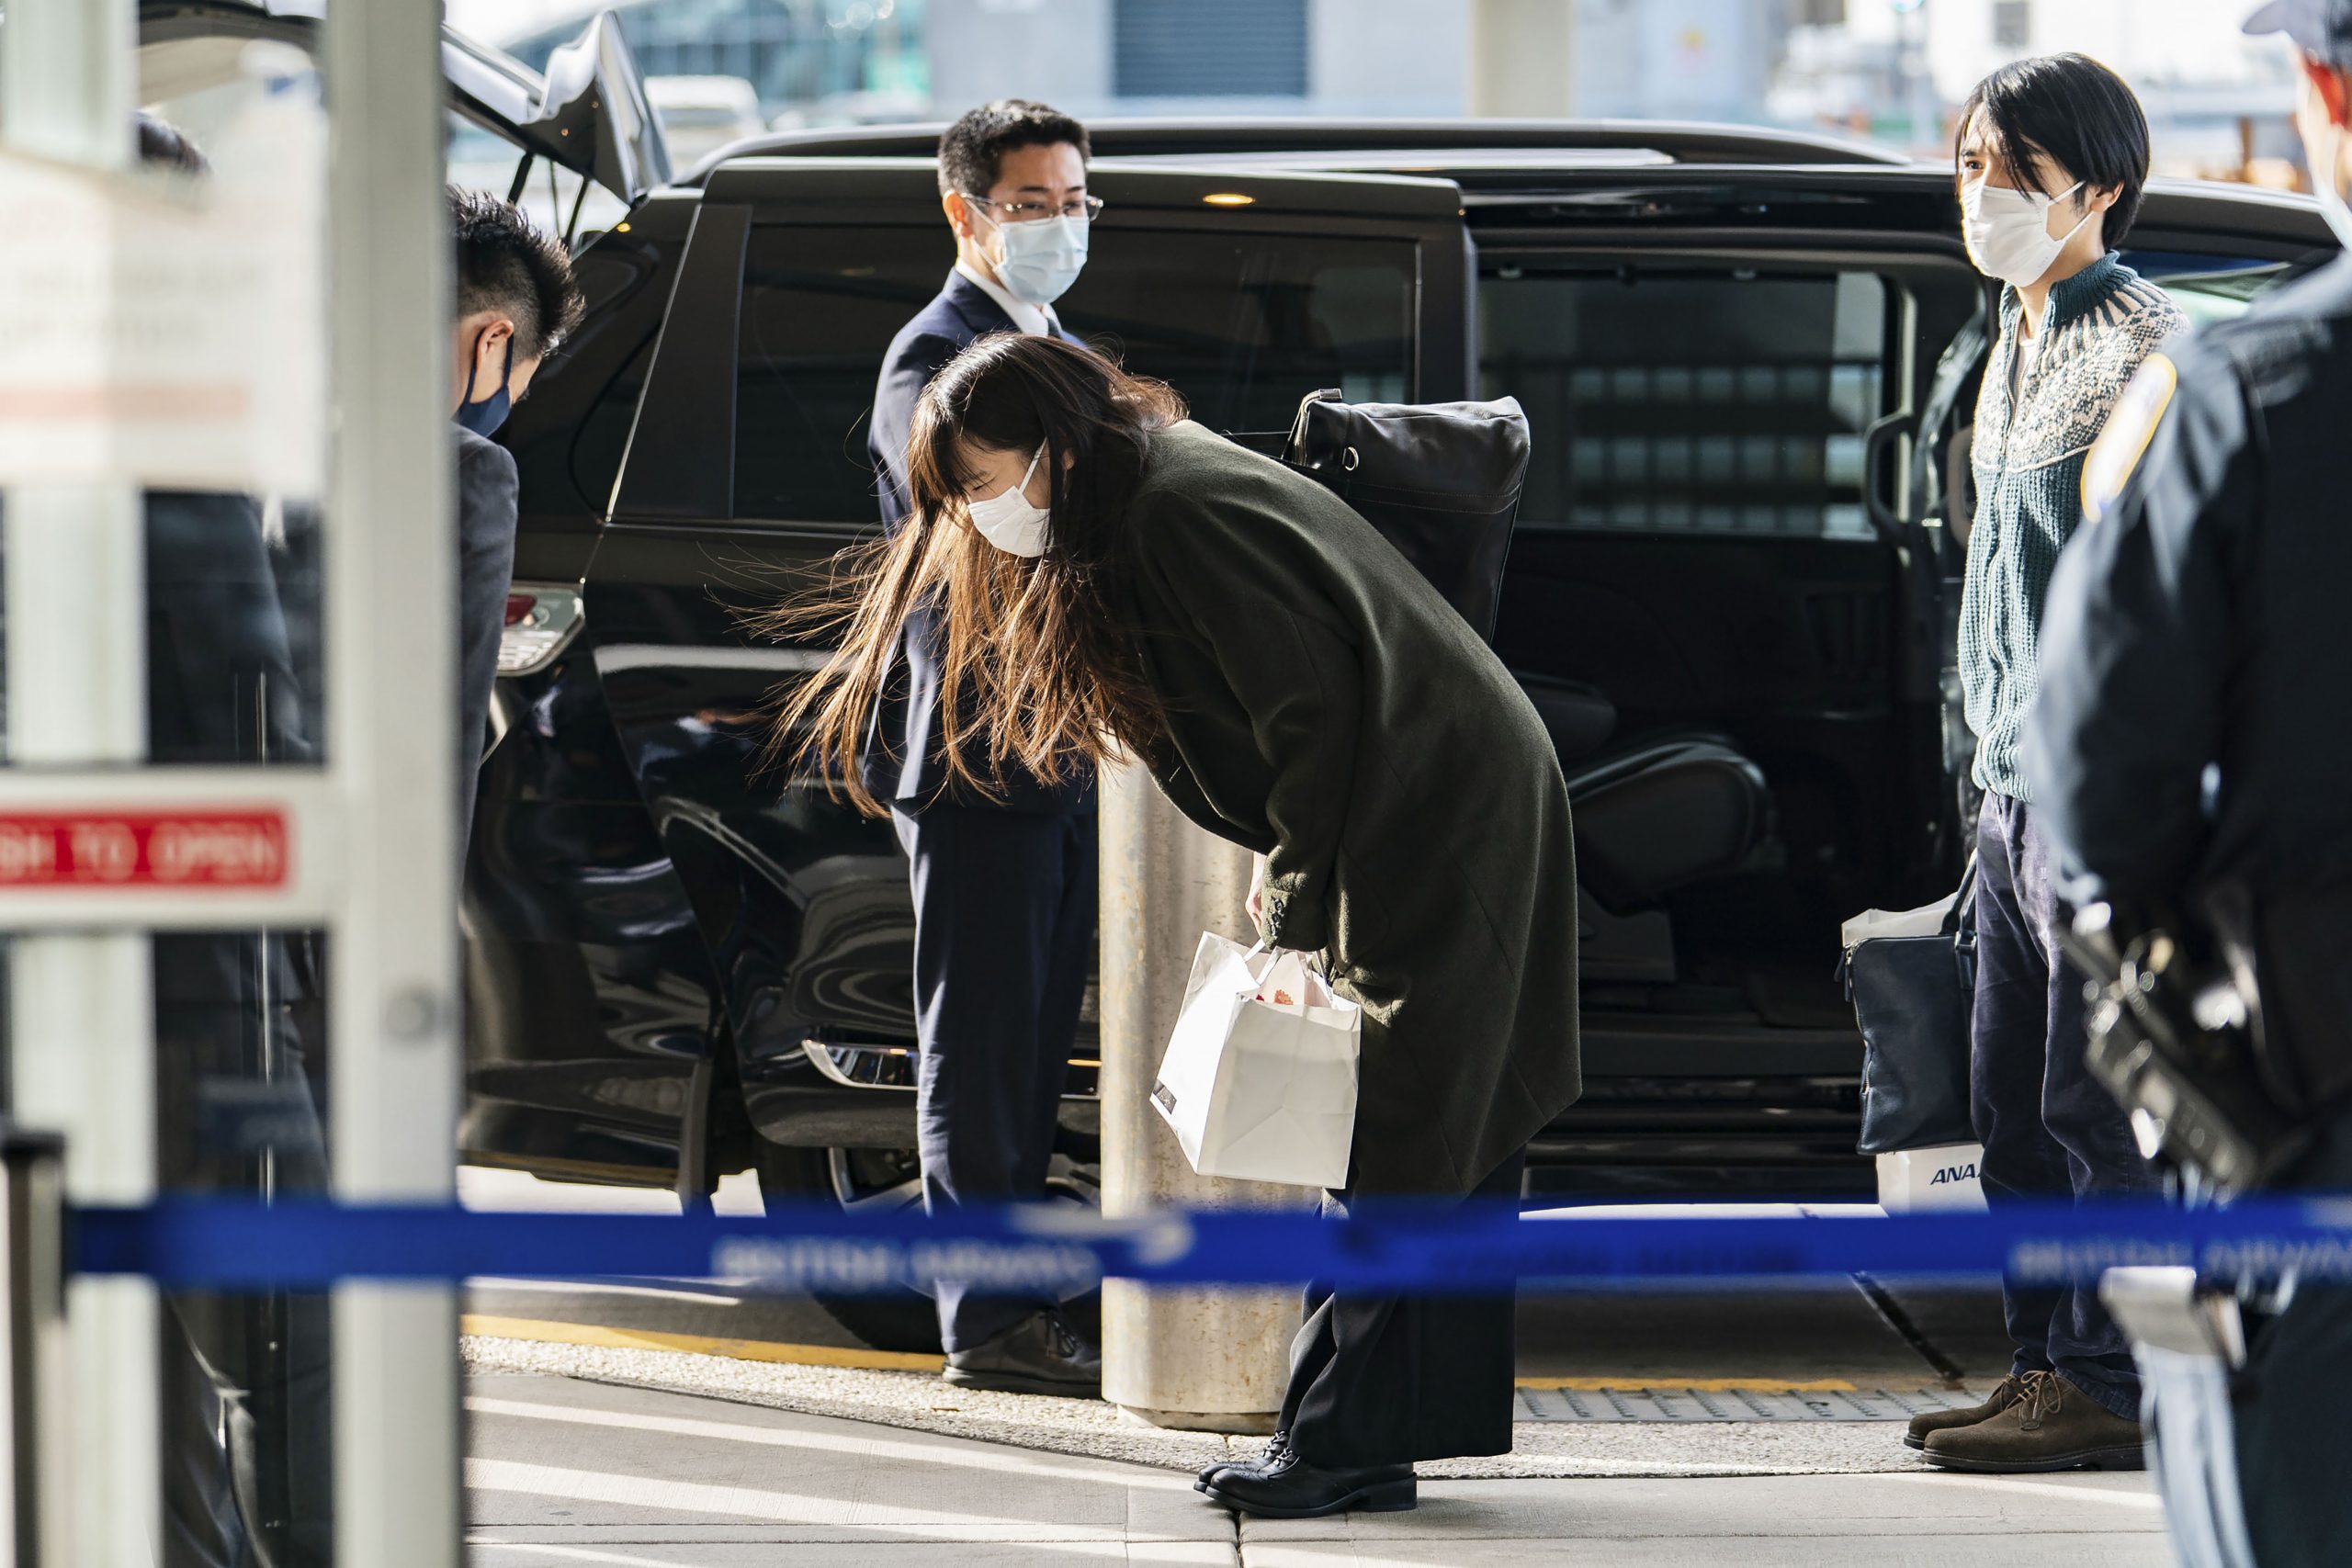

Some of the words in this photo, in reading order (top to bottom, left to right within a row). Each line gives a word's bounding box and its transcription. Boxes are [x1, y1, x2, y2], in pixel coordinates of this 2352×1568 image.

[73, 824, 137, 879] TO
[149, 824, 278, 879] OPEN
[1930, 1164, 1976, 1185] ANA
